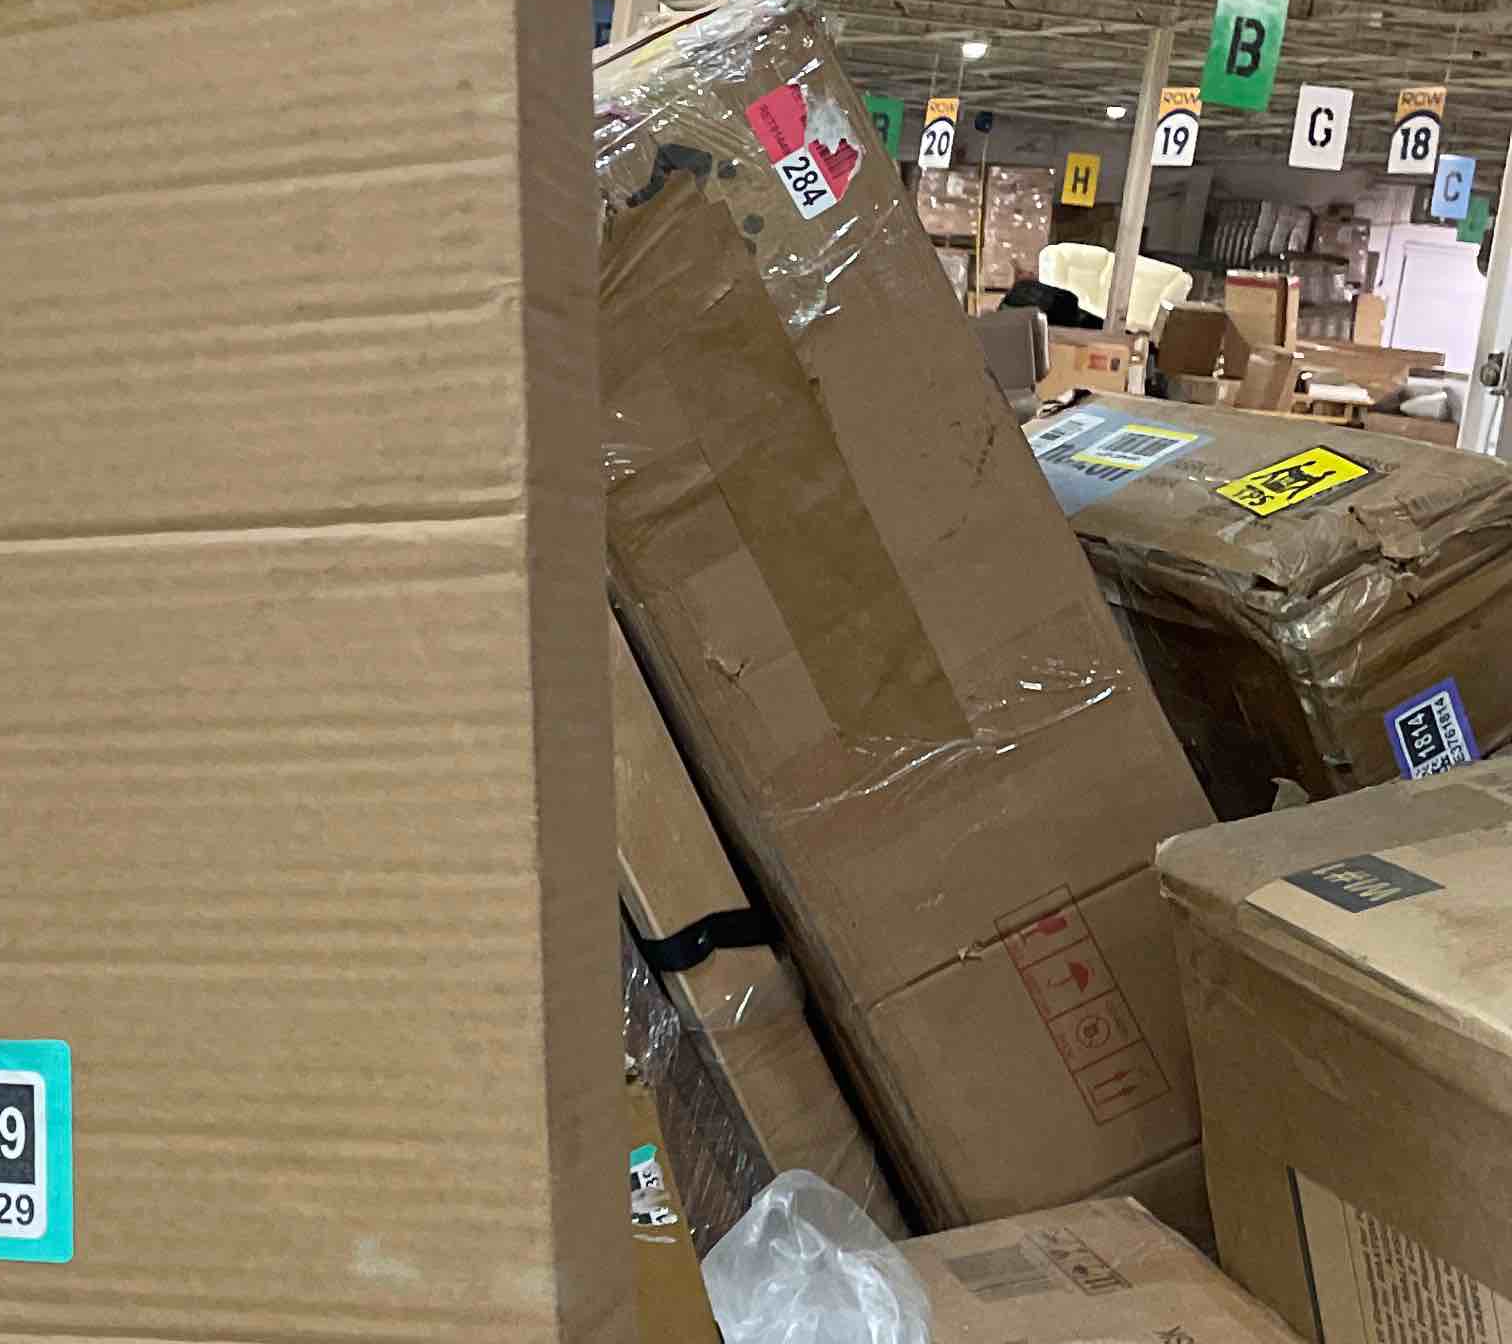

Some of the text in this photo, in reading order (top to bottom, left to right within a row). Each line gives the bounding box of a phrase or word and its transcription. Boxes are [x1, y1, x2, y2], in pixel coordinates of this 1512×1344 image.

[1225, 15, 1266, 78] B
[1400, 91, 1444, 106] ROW
[923, 130, 951, 156] 20
[1161, 126, 1189, 155] 19
[1399, 126, 1431, 161] 18
[782, 156, 827, 206] 284
[1071, 166, 1091, 195] H
[1443, 170, 1463, 202] C
[1408, 713, 1435, 757] 1814
